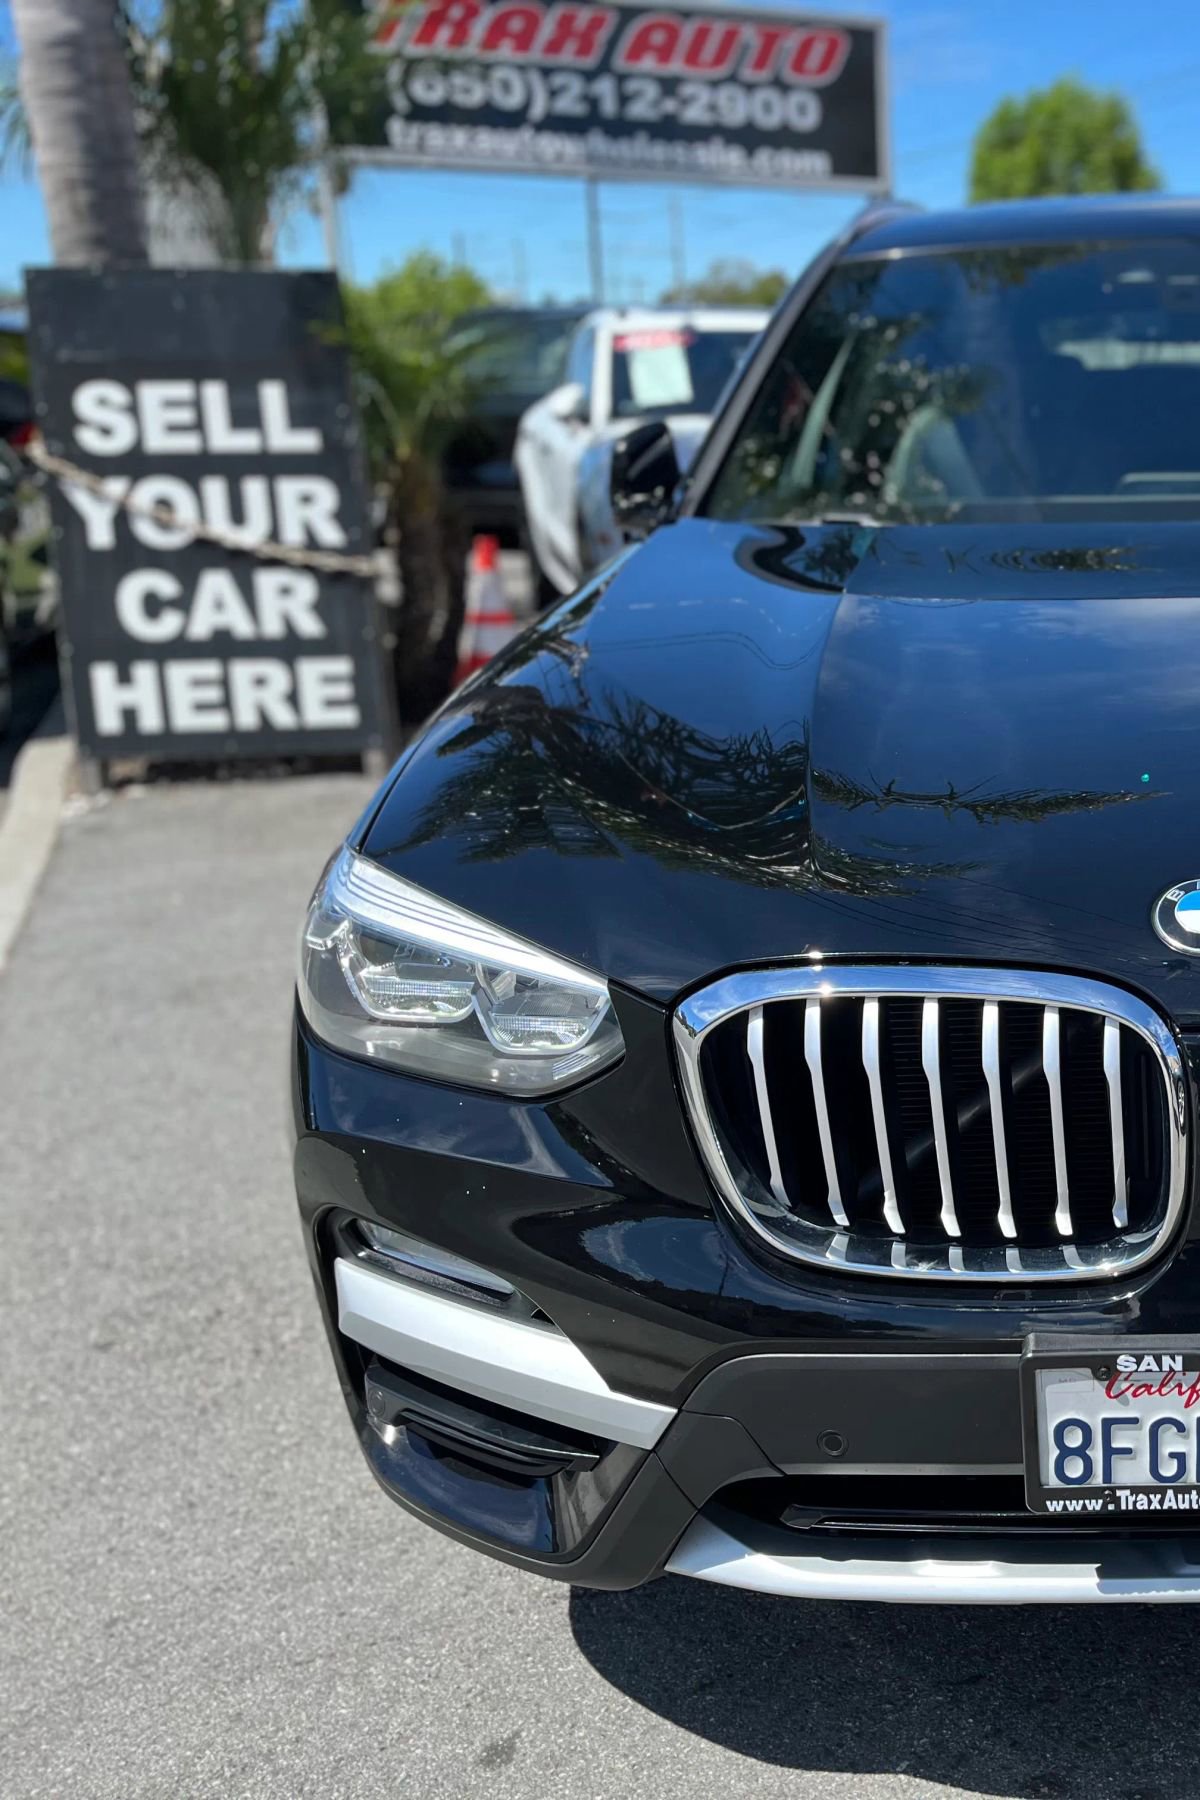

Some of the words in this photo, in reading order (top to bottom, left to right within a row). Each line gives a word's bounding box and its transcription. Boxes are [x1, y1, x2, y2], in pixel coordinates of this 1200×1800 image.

[611, 11, 851, 88] AUTO
[71, 379, 322, 456] SELL
[59, 474, 347, 551] YOUR
[115, 567, 325, 642] CAR
[89, 655, 360, 736] HERE
[1116, 1354, 1187, 1372] SAN
